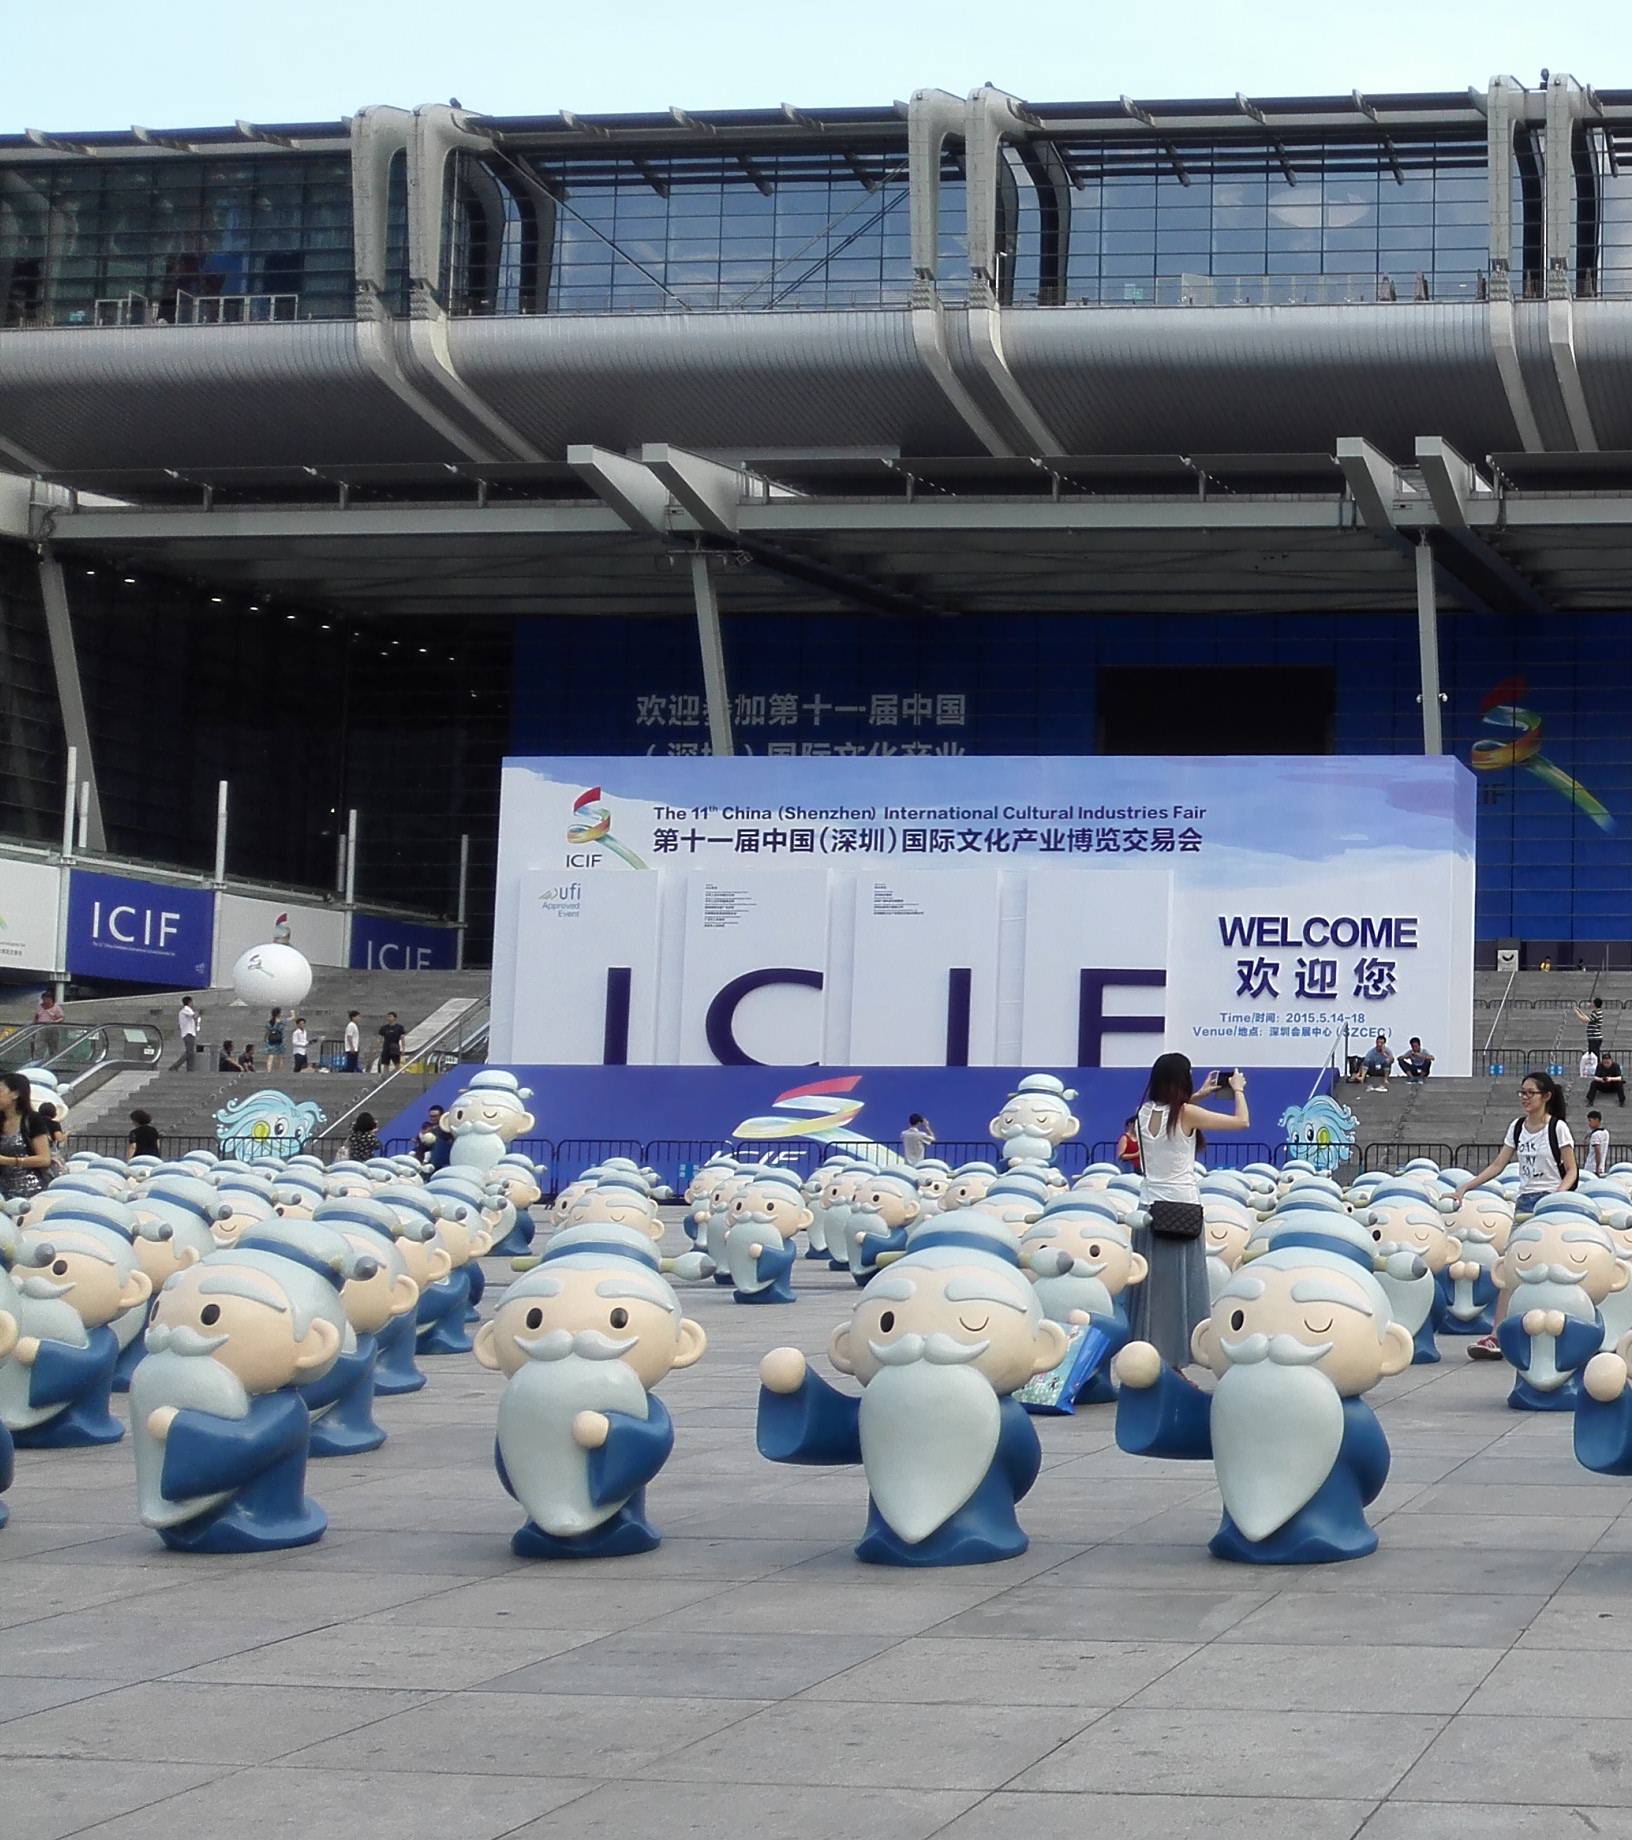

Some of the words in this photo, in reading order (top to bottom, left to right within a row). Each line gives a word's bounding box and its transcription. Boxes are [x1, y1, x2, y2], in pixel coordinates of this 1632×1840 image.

[635, 693, 966, 726] 欢迎加第十一届中国
[653, 806, 687, 820] The
[691, 805, 719, 820] 11th
[722, 806, 772, 820] China
[778, 805, 876, 822] (Shenzhen)
[884, 805, 998, 821] International
[1002, 805, 1074, 821] Cultural
[1078, 805, 1169, 821] Industries
[1173, 805, 1207, 821] Fair
[653, 826, 1203, 854] 第十一届中国（深圳）国际文化产业博览交易会
[566, 854, 603, 868] ICIF
[559, 882, 581, 900] ufi
[542, 901, 580, 910] Approved
[558, 910, 580, 918] Event
[92, 901, 181, 947] ICIF
[1218, 916, 1418, 949] WELCOME
[368, 940, 432, 970] ICIF
[1236, 957, 1397, 1000] 欢迎您
[603, 967, 1167, 1067] ICIF
[1285, 1012, 1366, 1024] 2015.5.14-18
